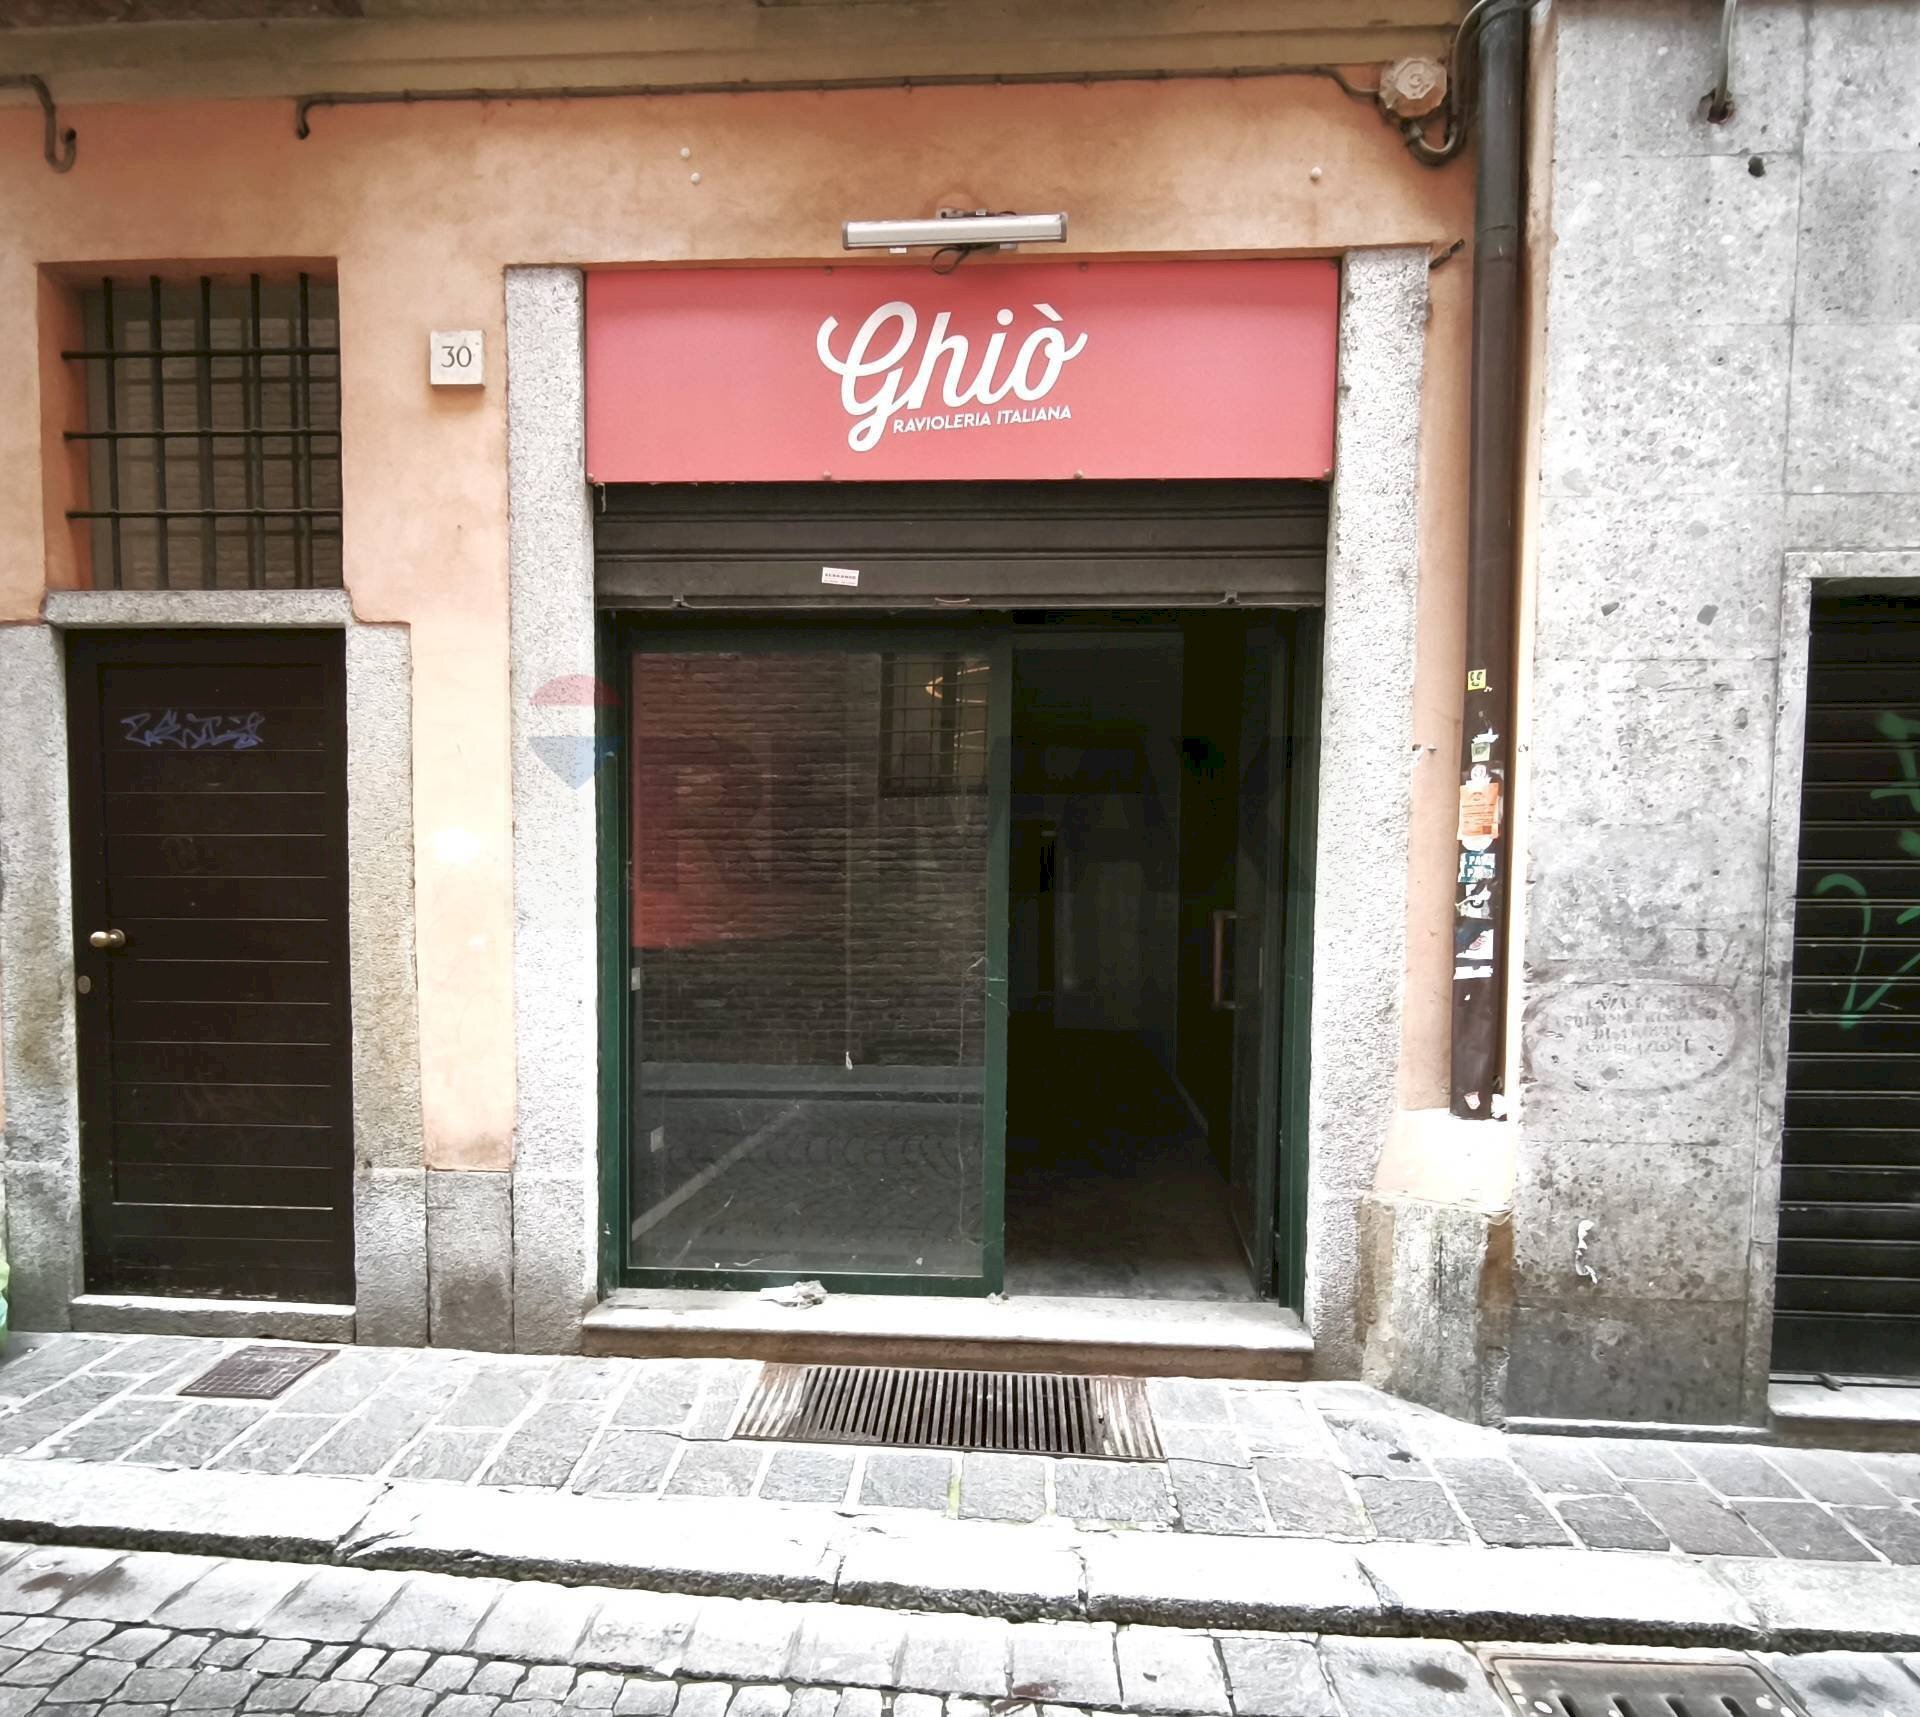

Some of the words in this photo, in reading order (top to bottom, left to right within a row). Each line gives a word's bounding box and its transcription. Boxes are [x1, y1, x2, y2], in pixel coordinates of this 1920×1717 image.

[440, 345, 473, 368] 30
[816, 301, 1089, 452] Ghiò
[893, 411, 991, 434] RAVIOLERIA
[996, 405, 1072, 425] ITALIANA
